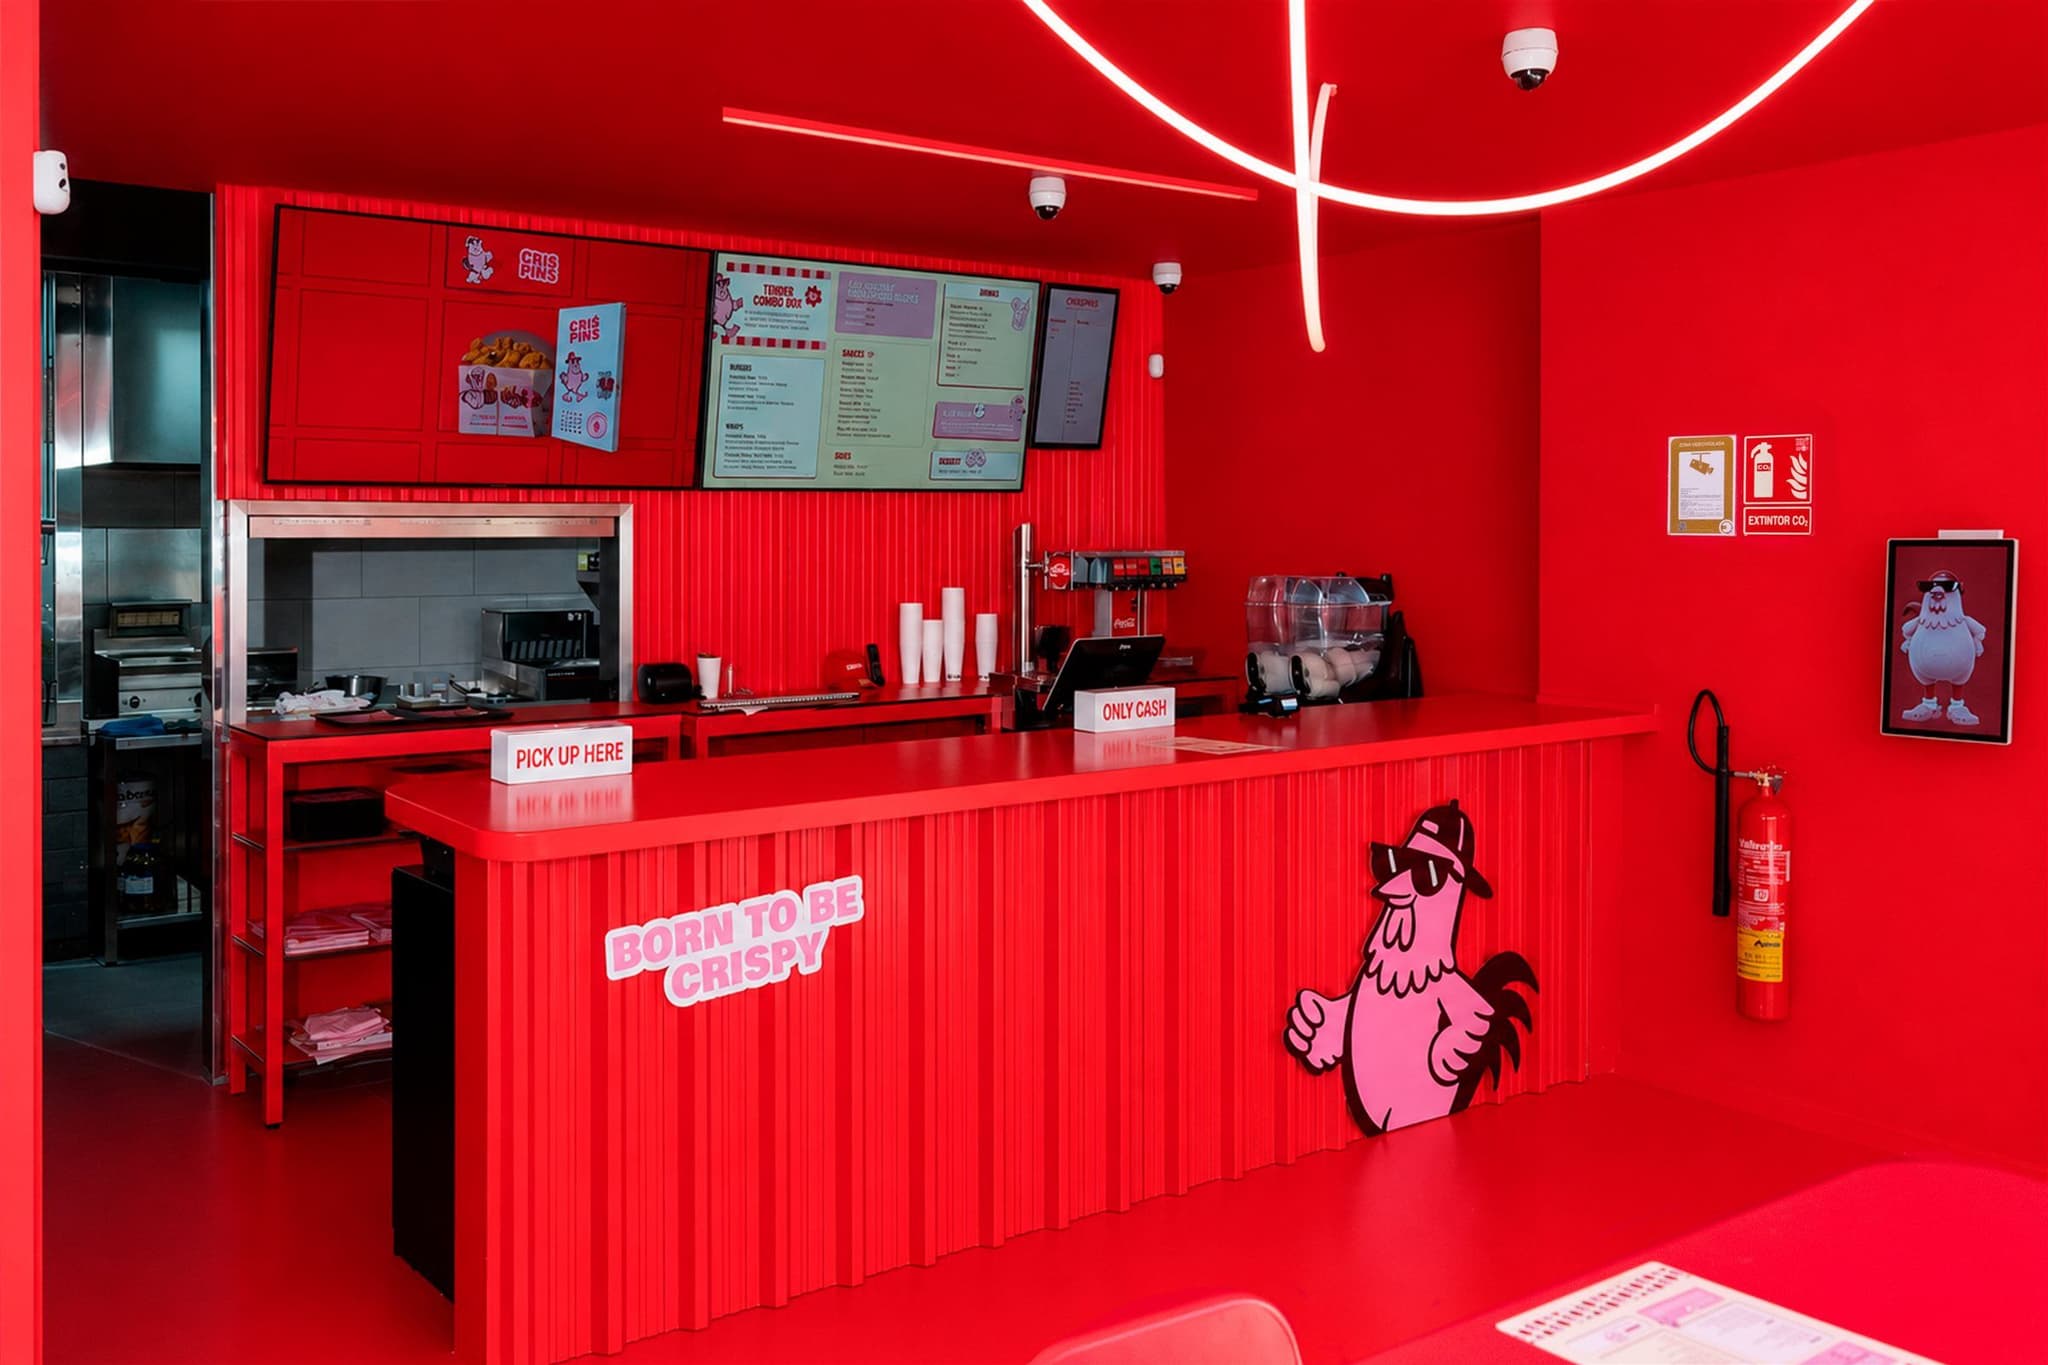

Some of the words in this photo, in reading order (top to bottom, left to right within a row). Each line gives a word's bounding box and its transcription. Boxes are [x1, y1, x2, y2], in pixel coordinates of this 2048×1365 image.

[521, 250, 557, 268] CRIS
[520, 264, 557, 281] PINS
[763, 284, 794, 297] TENDER
[753, 295, 784, 308] COMBO
[785, 298, 802, 309] BOX
[569, 329, 600, 344] PINS
[1748, 515, 1790, 526] EXTINTOR
[1103, 702, 1134, 721] ONLY
[1136, 699, 1167, 718] CASH
[516, 746, 554, 769] PICK
[558, 744, 580, 766] UP
[584, 741, 624, 764] HERE
[612, 911, 734, 972] BORN
[744, 897, 797, 938] TO
[809, 883, 858, 924] BE
[671, 931, 825, 1000] CRISPY
